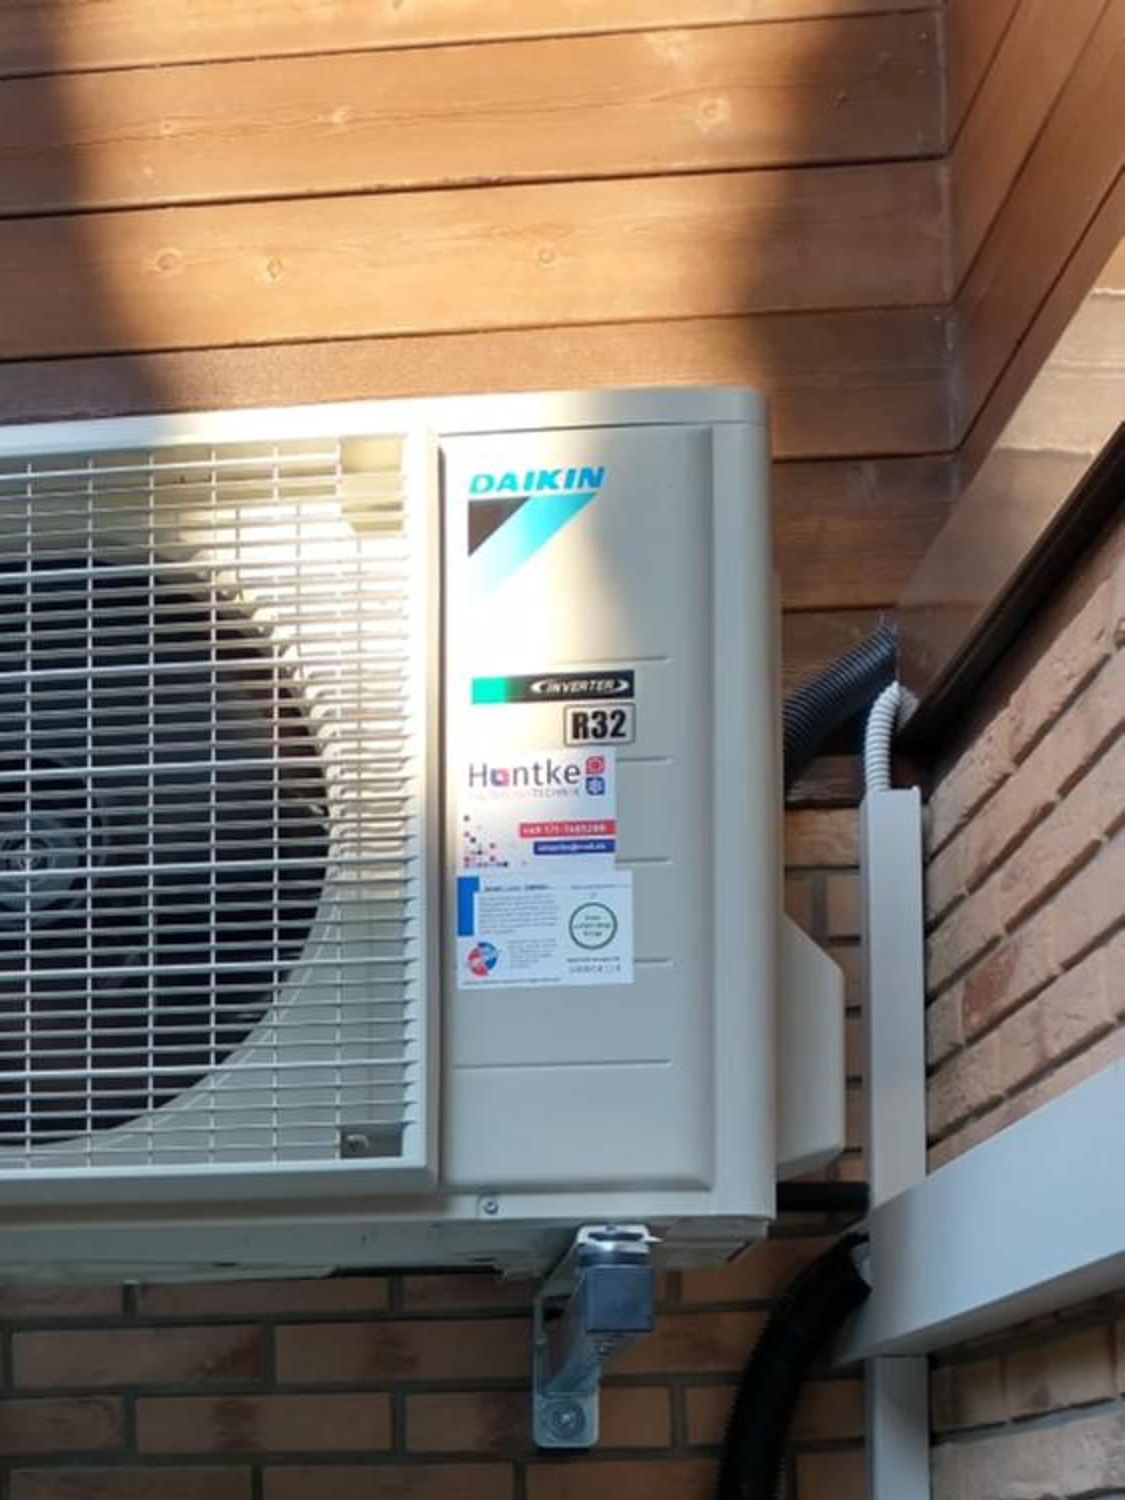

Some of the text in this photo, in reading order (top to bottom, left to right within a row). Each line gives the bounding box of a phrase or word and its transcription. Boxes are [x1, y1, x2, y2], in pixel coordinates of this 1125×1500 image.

[469, 466, 606, 494] DAIKIN
[546, 679, 617, 693] INVERTER
[571, 710, 627, 740] R32
